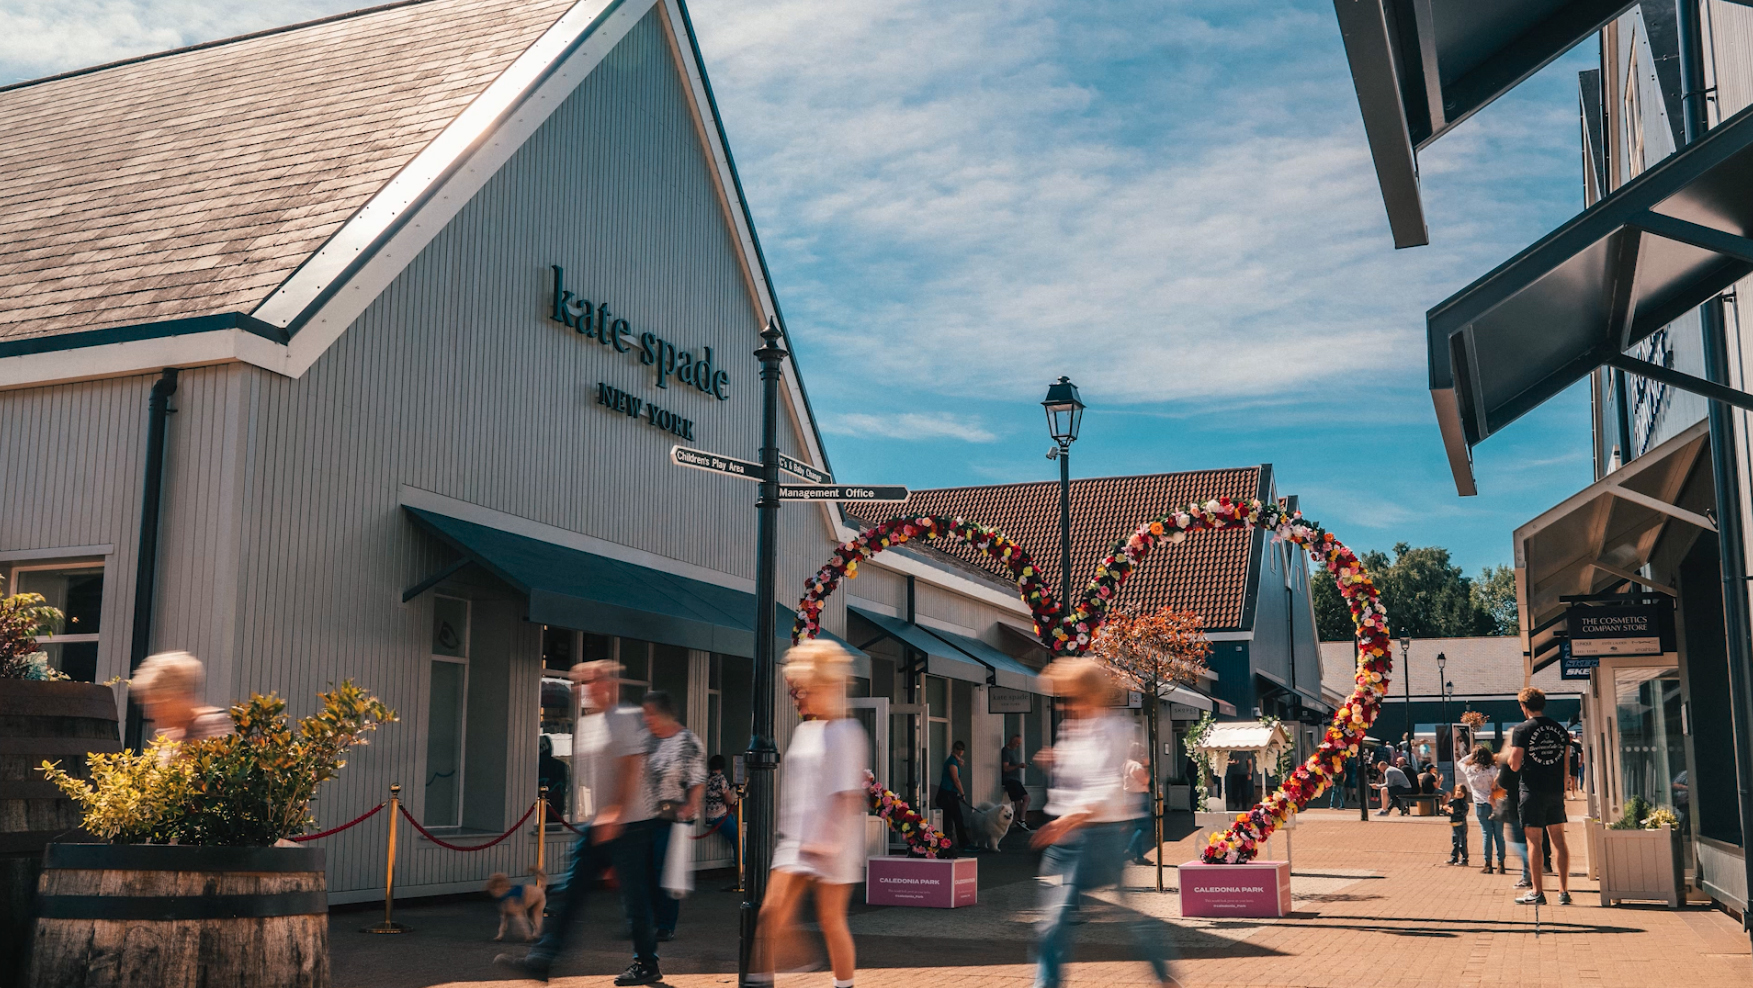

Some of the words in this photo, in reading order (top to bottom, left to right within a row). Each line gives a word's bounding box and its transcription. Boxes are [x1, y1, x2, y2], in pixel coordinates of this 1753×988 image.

[550, 264, 631, 353] kate
[640, 331, 730, 401] spade
[597, 382, 642, 418] NEW
[646, 403, 695, 442] YORK
[677, 451, 709, 466] Children's
[712, 458, 726, 471] Play
[729, 462, 744, 473] Area
[779, 458, 787, 468] C's
[793, 463, 804, 477] Baby
[805, 468, 822, 483] Change
[779, 487, 840, 499] Management
[845, 488, 875, 498] Office
[1582, 625, 1622, 633] COMPANY
[1623, 623, 1648, 631] STORE
[1600, 616, 1648, 625] COSMETICS
[1009, 694, 1028, 702] spade
